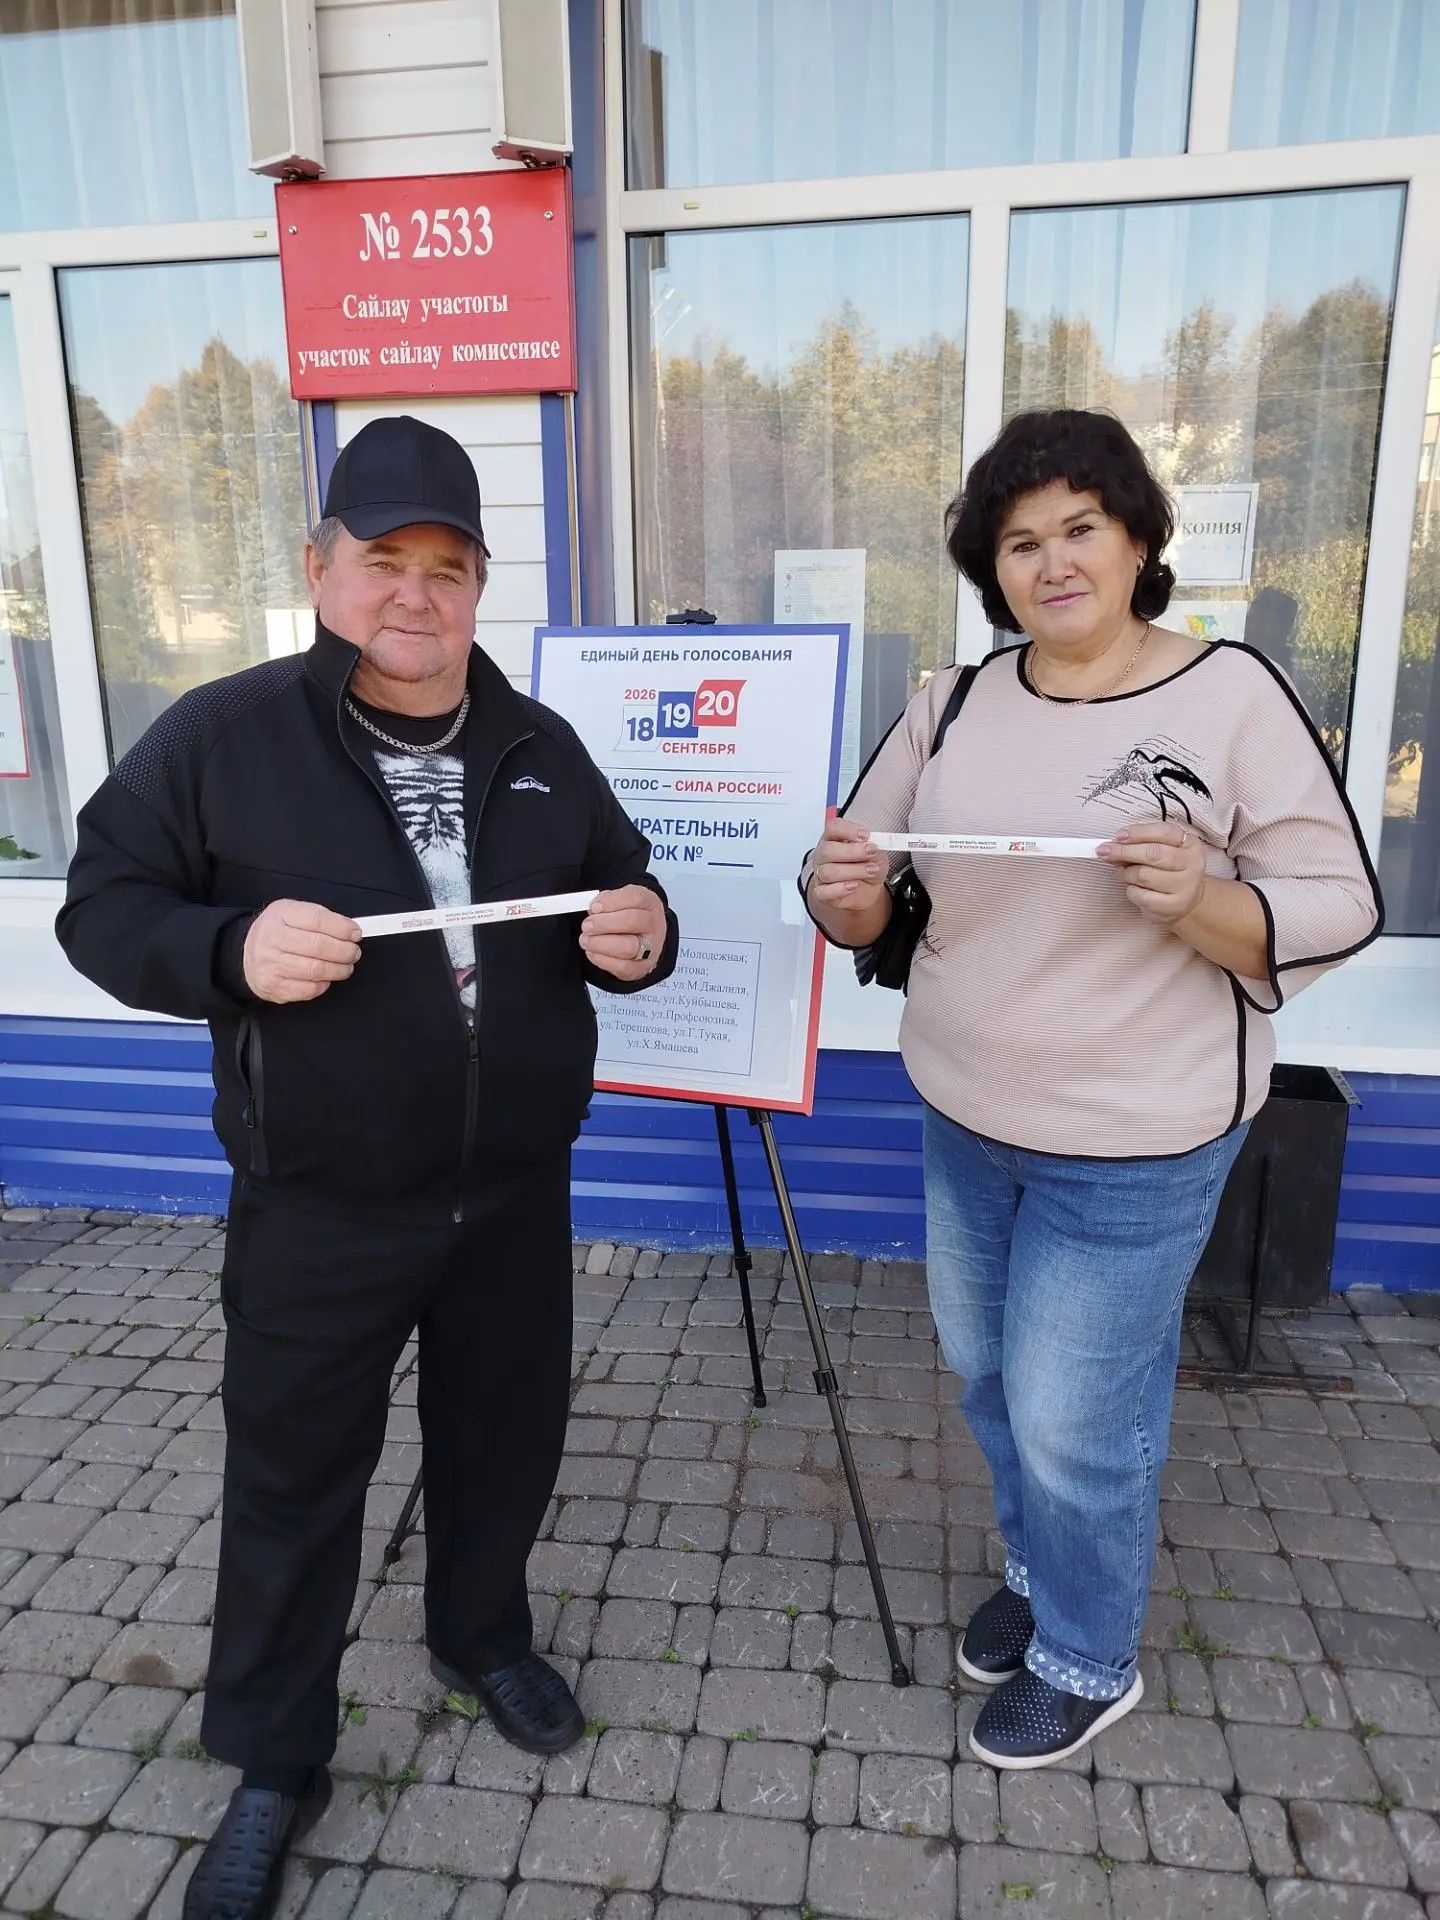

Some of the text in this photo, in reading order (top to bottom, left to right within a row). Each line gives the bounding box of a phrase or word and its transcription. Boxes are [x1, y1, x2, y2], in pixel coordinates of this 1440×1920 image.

[359, 205, 493, 262] № 2533
[342, 294, 508, 324] Сайлау участогы
[298, 338, 560, 375] участок сайлау комиссиясе
[580, 647, 792, 663] ЕДИНЫЙ ДЕНЬ ГОЛОСОВАНИЯ
[624, 688, 656, 700] 2026
[626, 690, 735, 742] 18 19 20
[662, 742, 736, 755] СЕНТЯБРЯ
[613, 778, 659, 791] ГОЛОС
[675, 780, 714, 793] СИЛА
[717, 782, 782, 795] РОССИИ!
